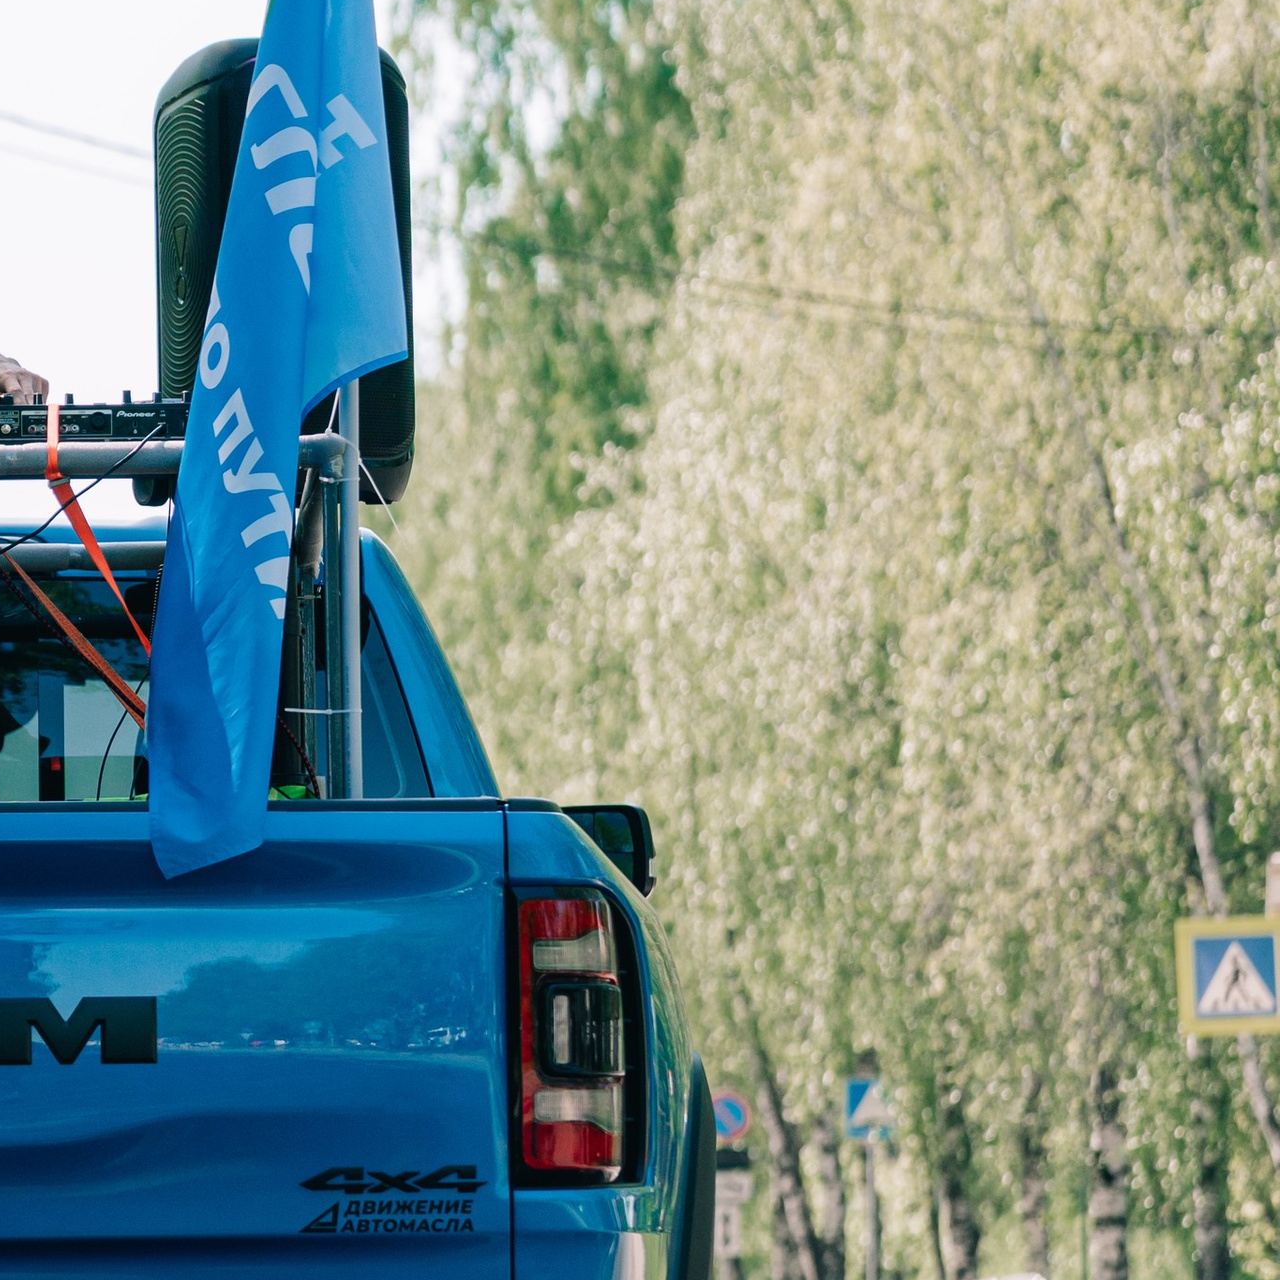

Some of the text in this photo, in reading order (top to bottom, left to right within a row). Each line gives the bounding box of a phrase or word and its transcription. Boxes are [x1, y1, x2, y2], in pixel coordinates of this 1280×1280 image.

[116, 410, 155, 418] Pioneer
[343, 1200, 474, 1217] ДВИЖЕНИЕ
[340, 1218, 474, 1233] АВТОМАСЛА
